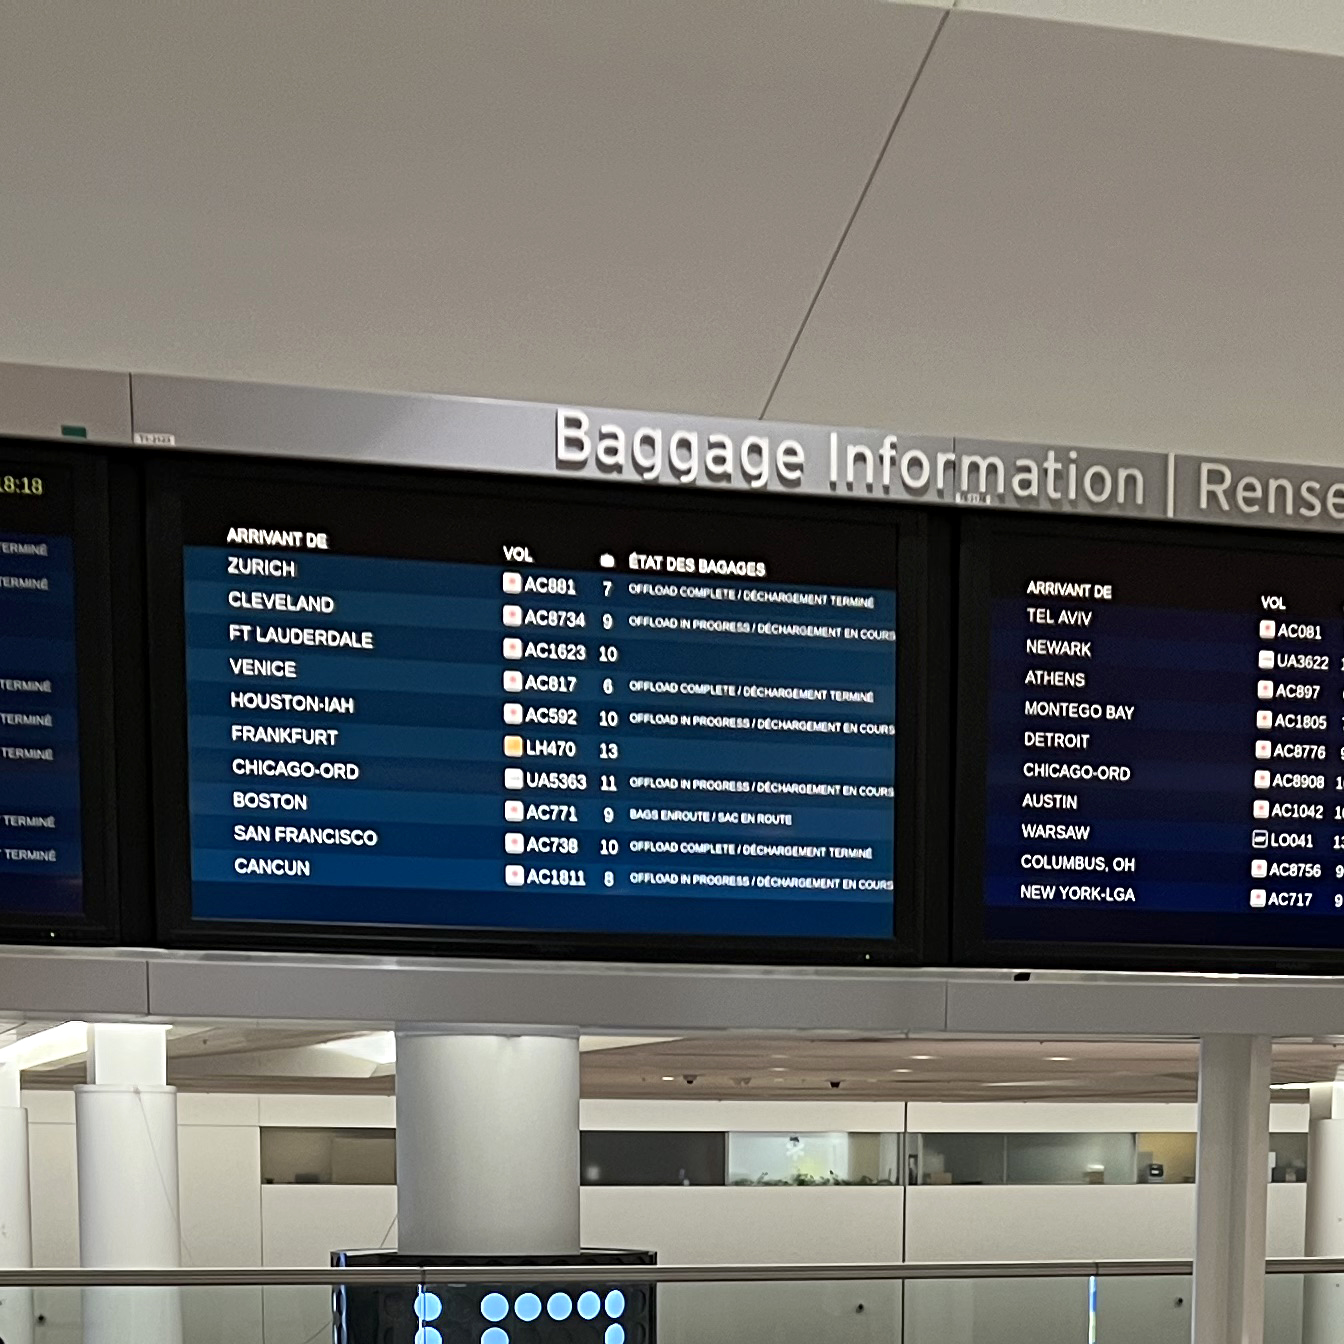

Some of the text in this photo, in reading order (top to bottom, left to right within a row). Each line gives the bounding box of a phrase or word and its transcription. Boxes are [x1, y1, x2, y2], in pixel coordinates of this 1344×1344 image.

[554, 406, 1145, 507] Baggage Information
[227, 527, 328, 549] ARRIVANT DE
[503, 545, 533, 563] VOL
[227, 556, 295, 577] ZURICH
[629, 551, 766, 577] ÉTAT DES BAGAGES
[524, 576, 576, 595] AC881
[1027, 580, 1112, 599] ARRIVANT DE
[228, 591, 334, 613] CLEVELAND
[1261, 595, 1286, 610] VOL
[525, 609, 586, 627] AC8734
[1027, 608, 1092, 626] TEL AVIV
[229, 624, 374, 649] FT LAUDERDALE
[1277, 623, 1322, 640] AC081
[525, 642, 586, 660] AC1623
[1027, 639, 1091, 657] NEWARK
[229, 658, 297, 678] VENICE
[1277, 653, 1329, 670] UA3622
[525, 674, 577, 692] AC817
[1025, 670, 1085, 687] ATHENS
[1275, 683, 1320, 699] AC897
[231, 691, 354, 713] HOUSTON-IAH
[1025, 700, 1134, 720] MONTEGO BAY
[525, 707, 577, 725] AC592
[1274, 713, 1327, 730] AC1805
[232, 725, 339, 746] FRANKFURT
[1024, 731, 1090, 748] DETROIT
[527, 739, 576, 757] LH470
[1273, 743, 1326, 759] AC8776
[232, 758, 359, 780] CHICAGO-ORD
[1023, 763, 1131, 781] CHICAGO-ORD
[527, 771, 587, 790] UA5363
[1272, 773, 1325, 789] AC8908
[233, 791, 307, 810] BOSTON
[1022, 793, 1077, 809] AUSTIN
[526, 804, 578, 822] AC771
[1271, 803, 1324, 819] AC1042
[234, 825, 378, 846] SAN FRANCISCO
[1021, 823, 1090, 840] WARSAW
[1271, 833, 1313, 848] LO041
[527, 836, 578, 854] AC738
[234, 858, 310, 876] CANCUN
[1021, 854, 1135, 872] COLUMBUS, OH
[1269, 862, 1321, 878] AC8756
[527, 868, 586, 886] AC1811
[1021, 884, 1136, 902] NEW YORK-LGA
[1268, 892, 1313, 907] AC717
